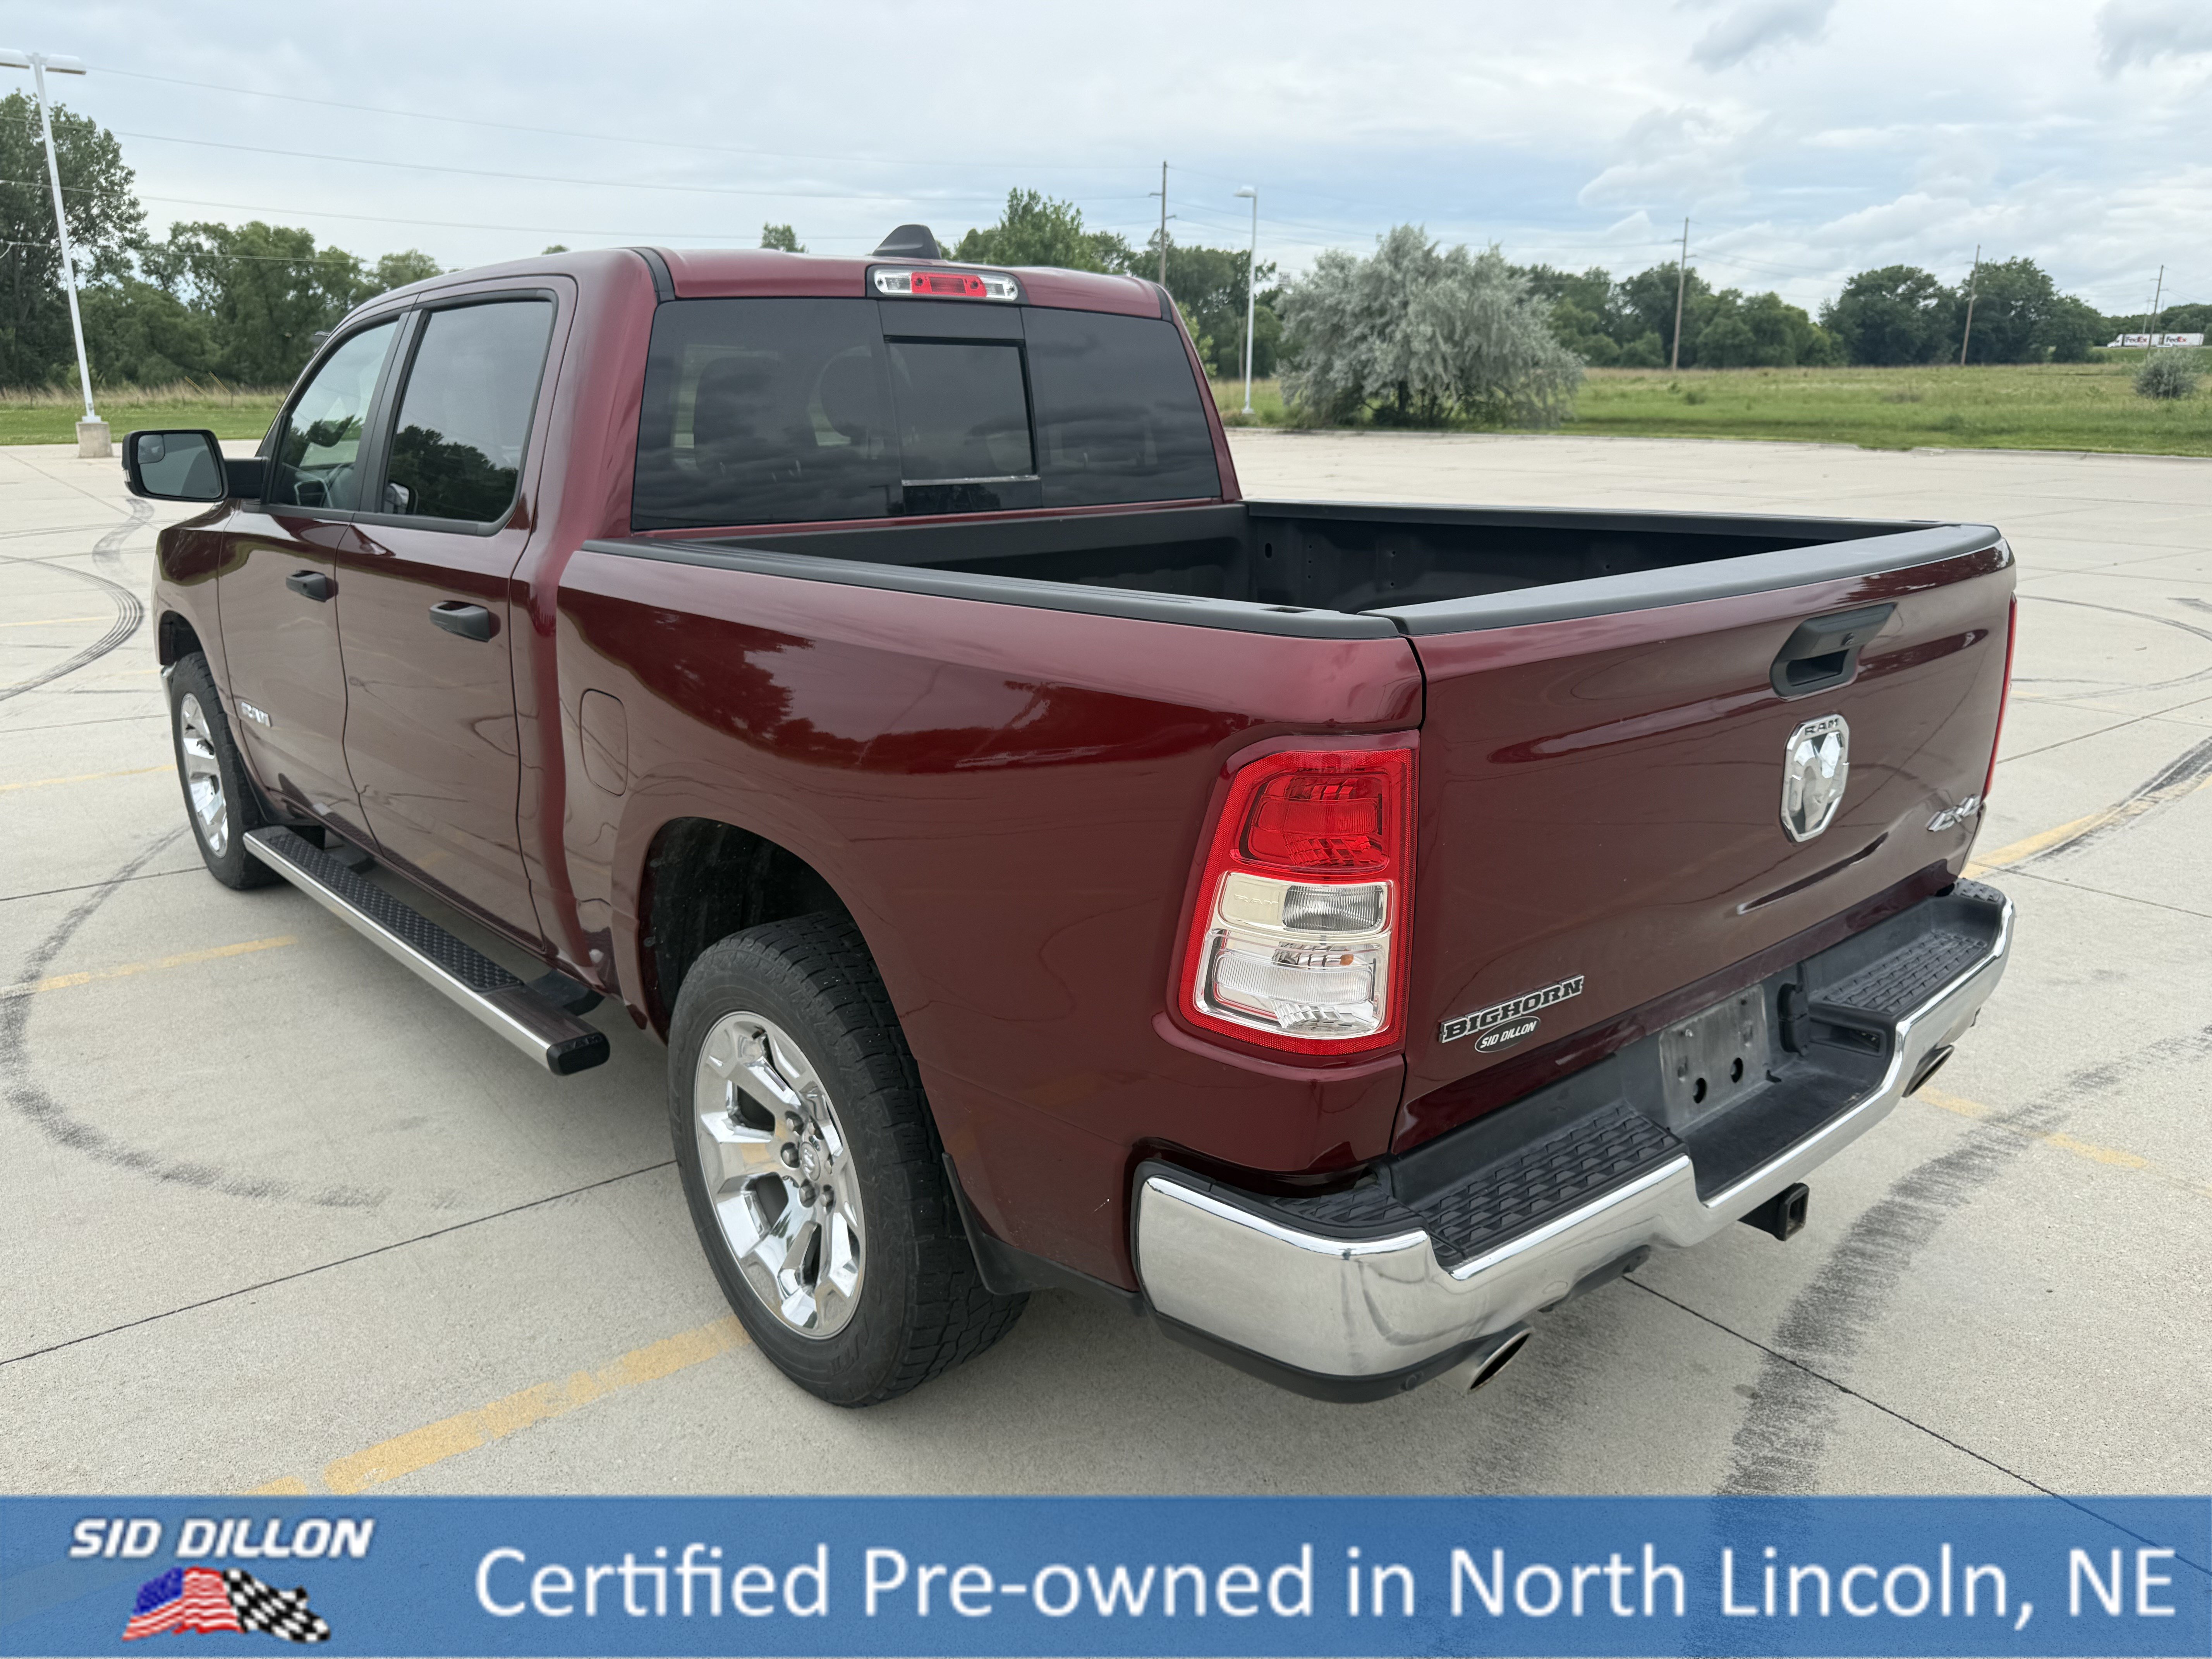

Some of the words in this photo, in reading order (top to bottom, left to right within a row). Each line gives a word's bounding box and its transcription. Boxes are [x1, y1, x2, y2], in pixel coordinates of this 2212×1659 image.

[1805, 718, 1839, 735] RAM
[1234, 894, 1278, 905] RAM
[1439, 975, 1585, 1043] BIGHORN
[1480, 1034, 1499, 1049] SID
[1499, 1020, 1537, 1042] DILLON
